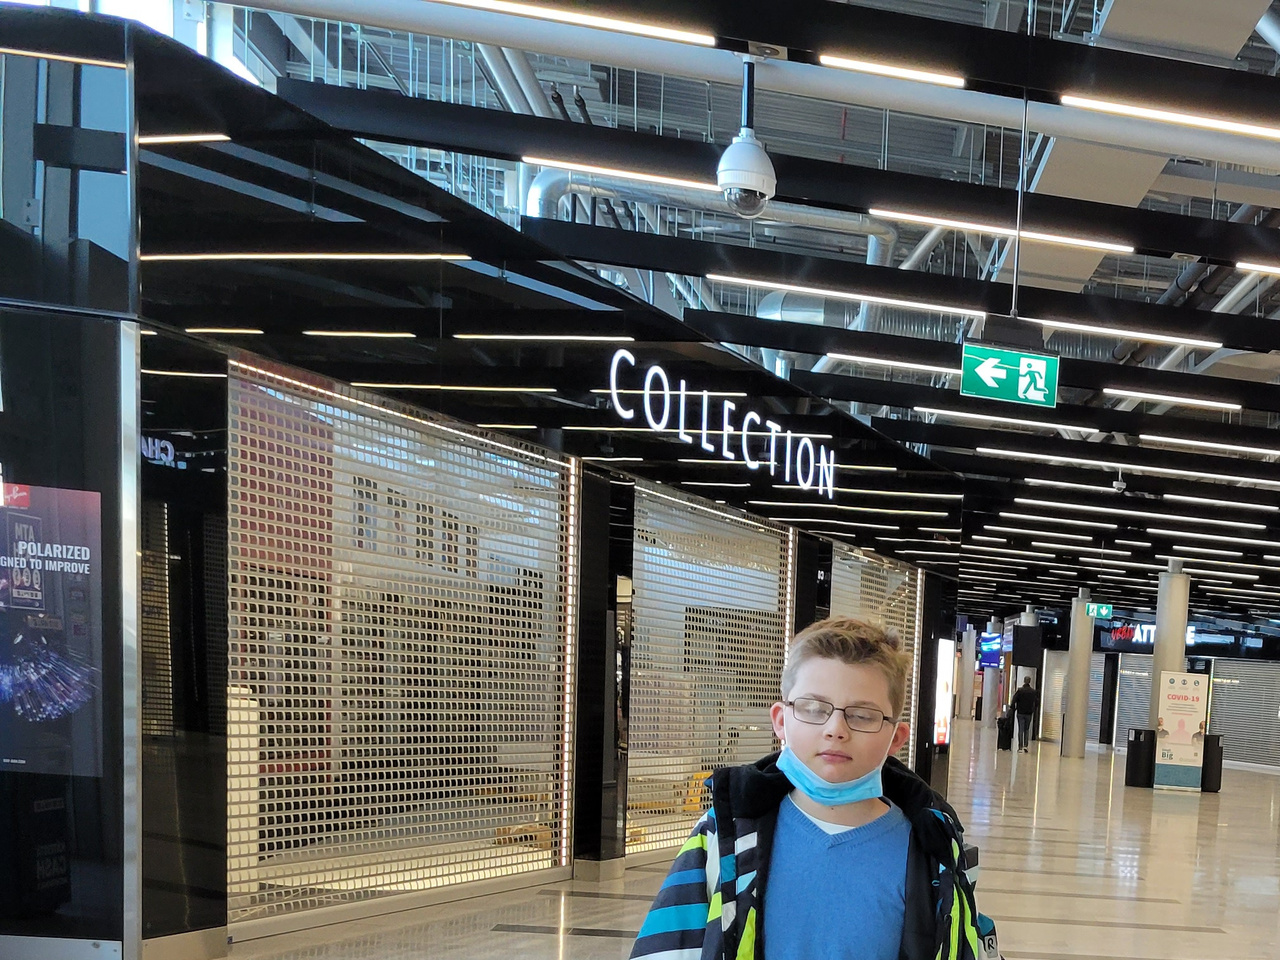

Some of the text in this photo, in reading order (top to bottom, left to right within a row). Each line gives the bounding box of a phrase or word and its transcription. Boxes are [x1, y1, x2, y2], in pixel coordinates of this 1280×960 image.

[610, 348, 835, 500] COLLECTION
[18, 541, 91, 561] POLARIZED
[0, 556, 91, 575] GNED TO IMPROVE
[1167, 693, 1200, 702] COVID-19
